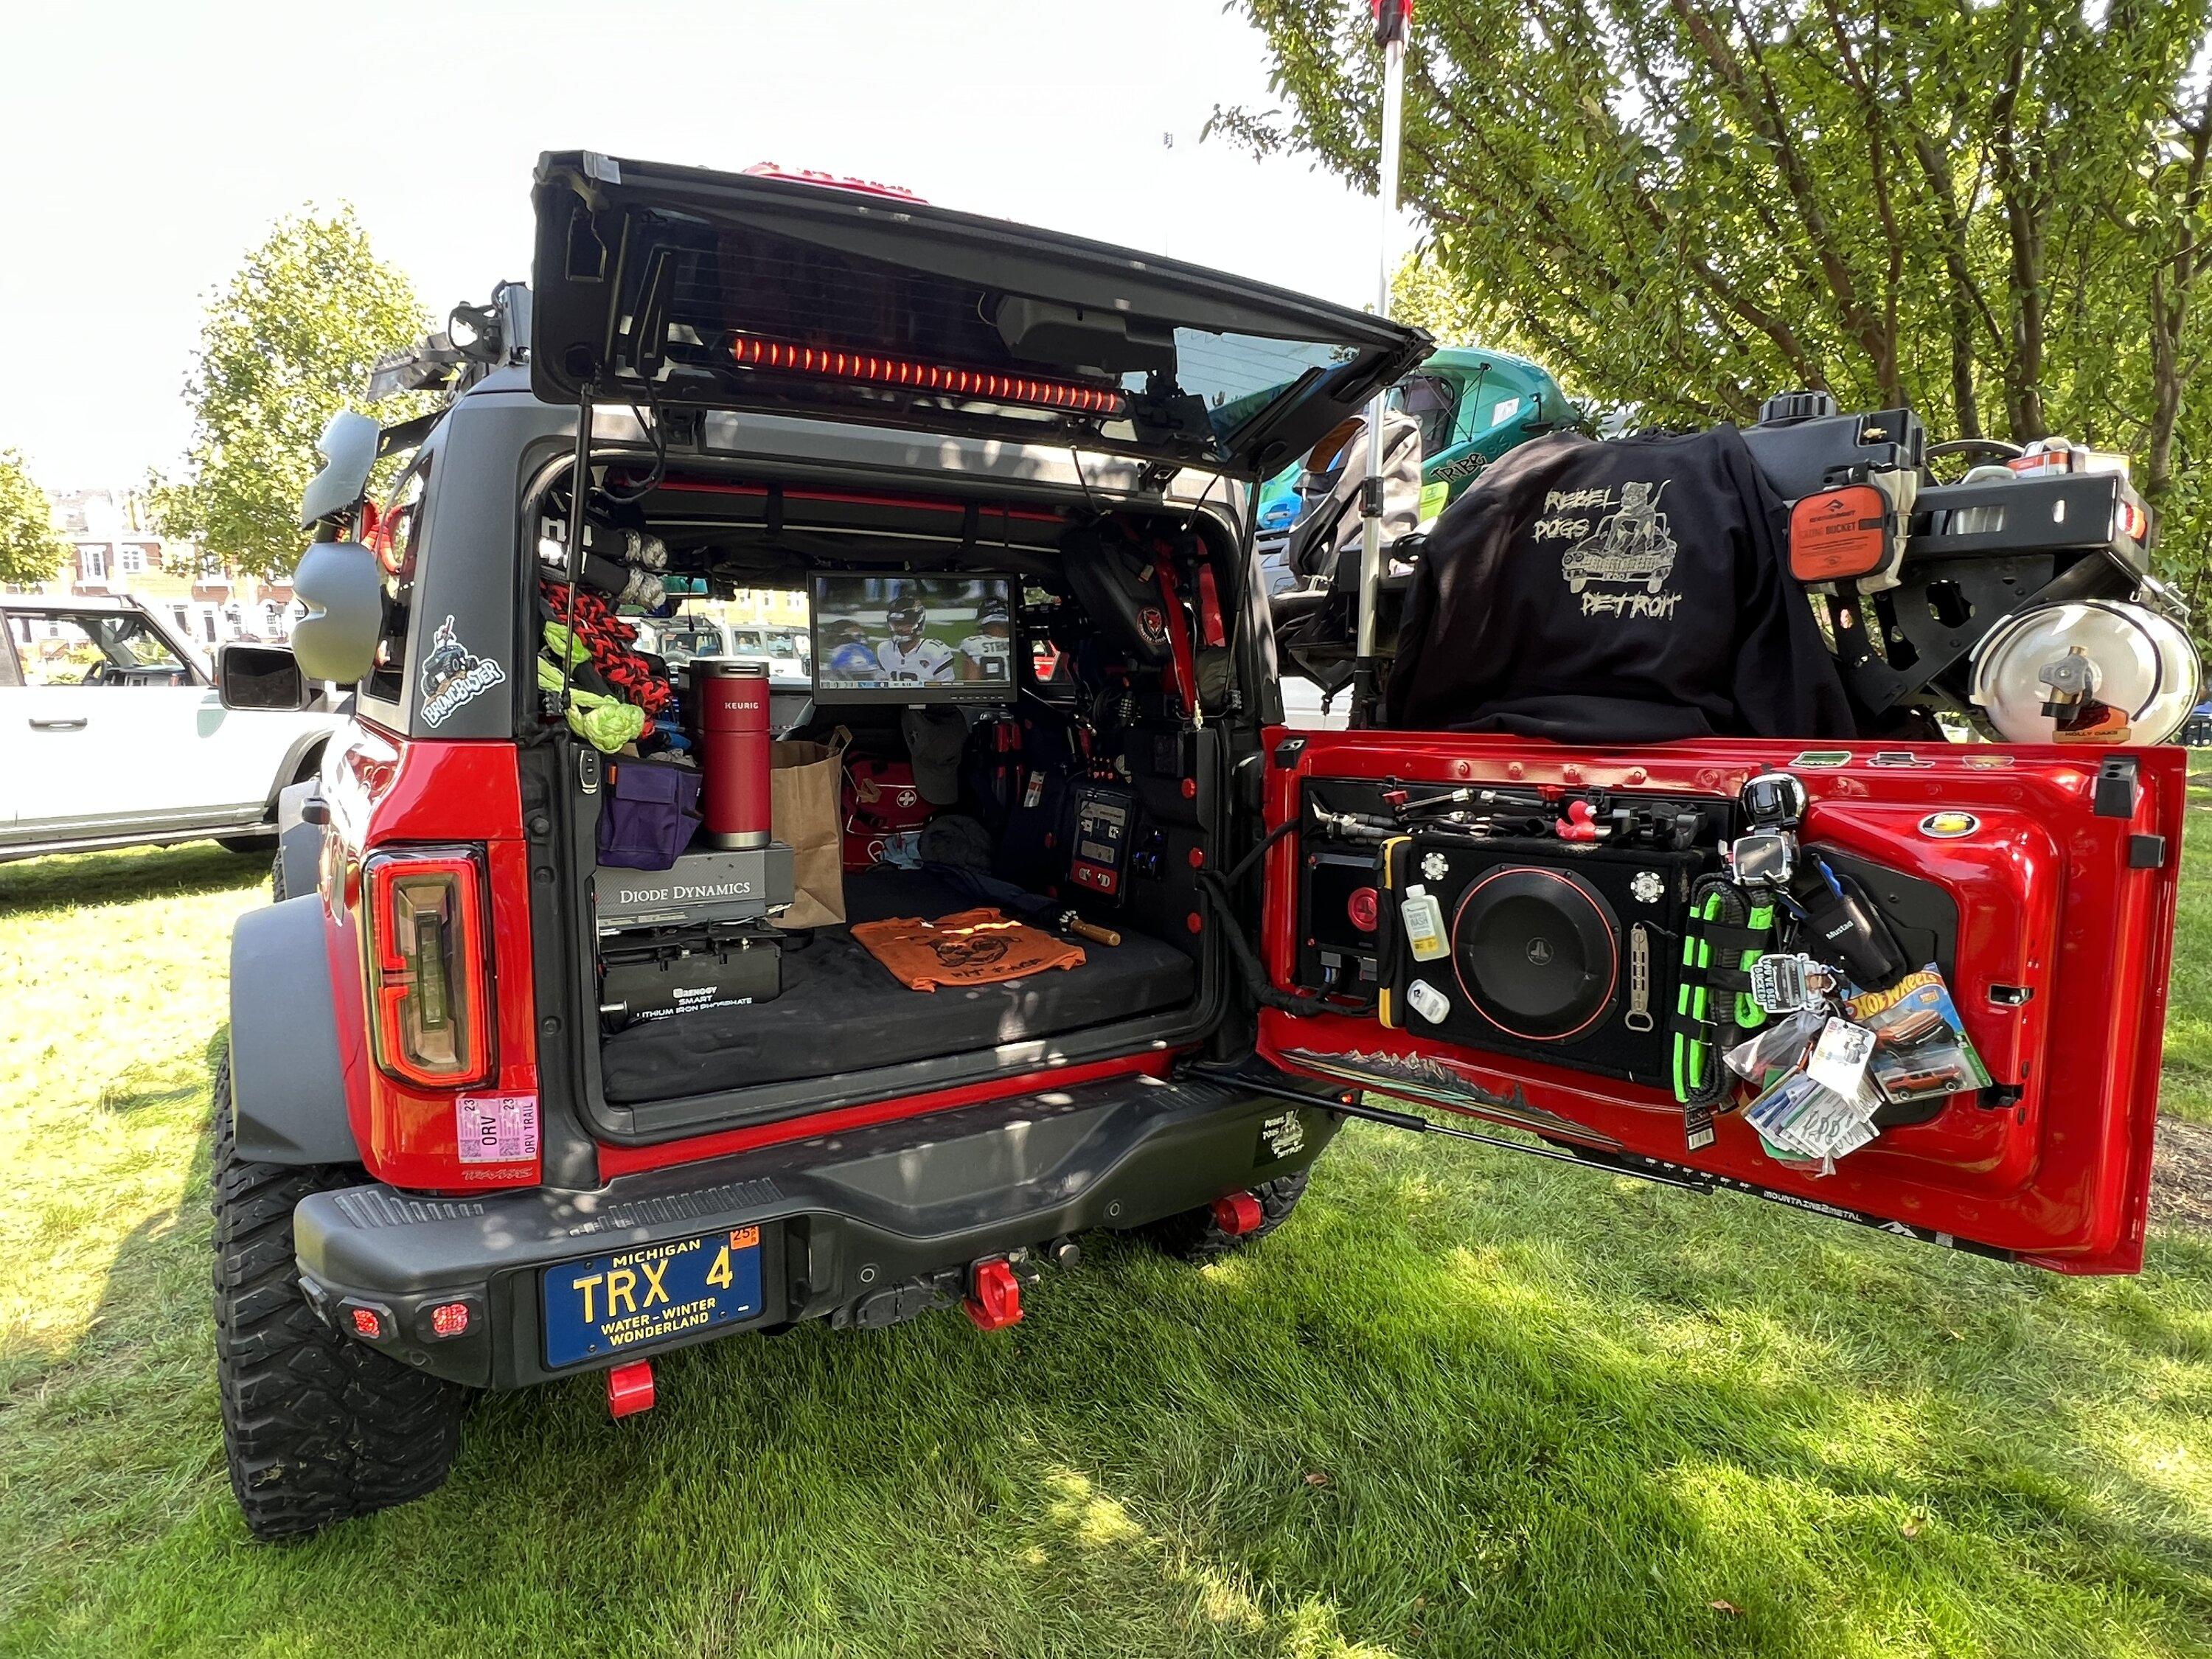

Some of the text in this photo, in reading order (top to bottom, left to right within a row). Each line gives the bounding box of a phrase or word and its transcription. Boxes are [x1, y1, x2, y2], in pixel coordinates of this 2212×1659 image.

[1430, 452, 1487, 484] TRIBE
[1543, 484, 1621, 515] REBEL
[1531, 516, 1590, 544] DOGS
[1826, 521, 1856, 535] BUCKET
[1580, 590, 1683, 621] DETROIT
[424, 662, 501, 723] BRONCBUSTER
[620, 882, 751, 903] DIODE DYNAMICS
[675, 1004, 699, 1014] IRON
[678, 995, 713, 1006] SMART
[1853, 972, 1938, 1021] HOT WHEELS
[465, 1099, 476, 1111] 23
[503, 1098, 515, 1110] 23
[481, 1116, 497, 1145] ORV
[523, 1102, 535, 1153] ORV TRAIL
[733, 1228, 750, 1241] 25
[612, 1239, 700, 1268] MICHIGAN
[573, 1245, 733, 1324] TRX 4
[610, 1311, 709, 1346] WONDERLAND
